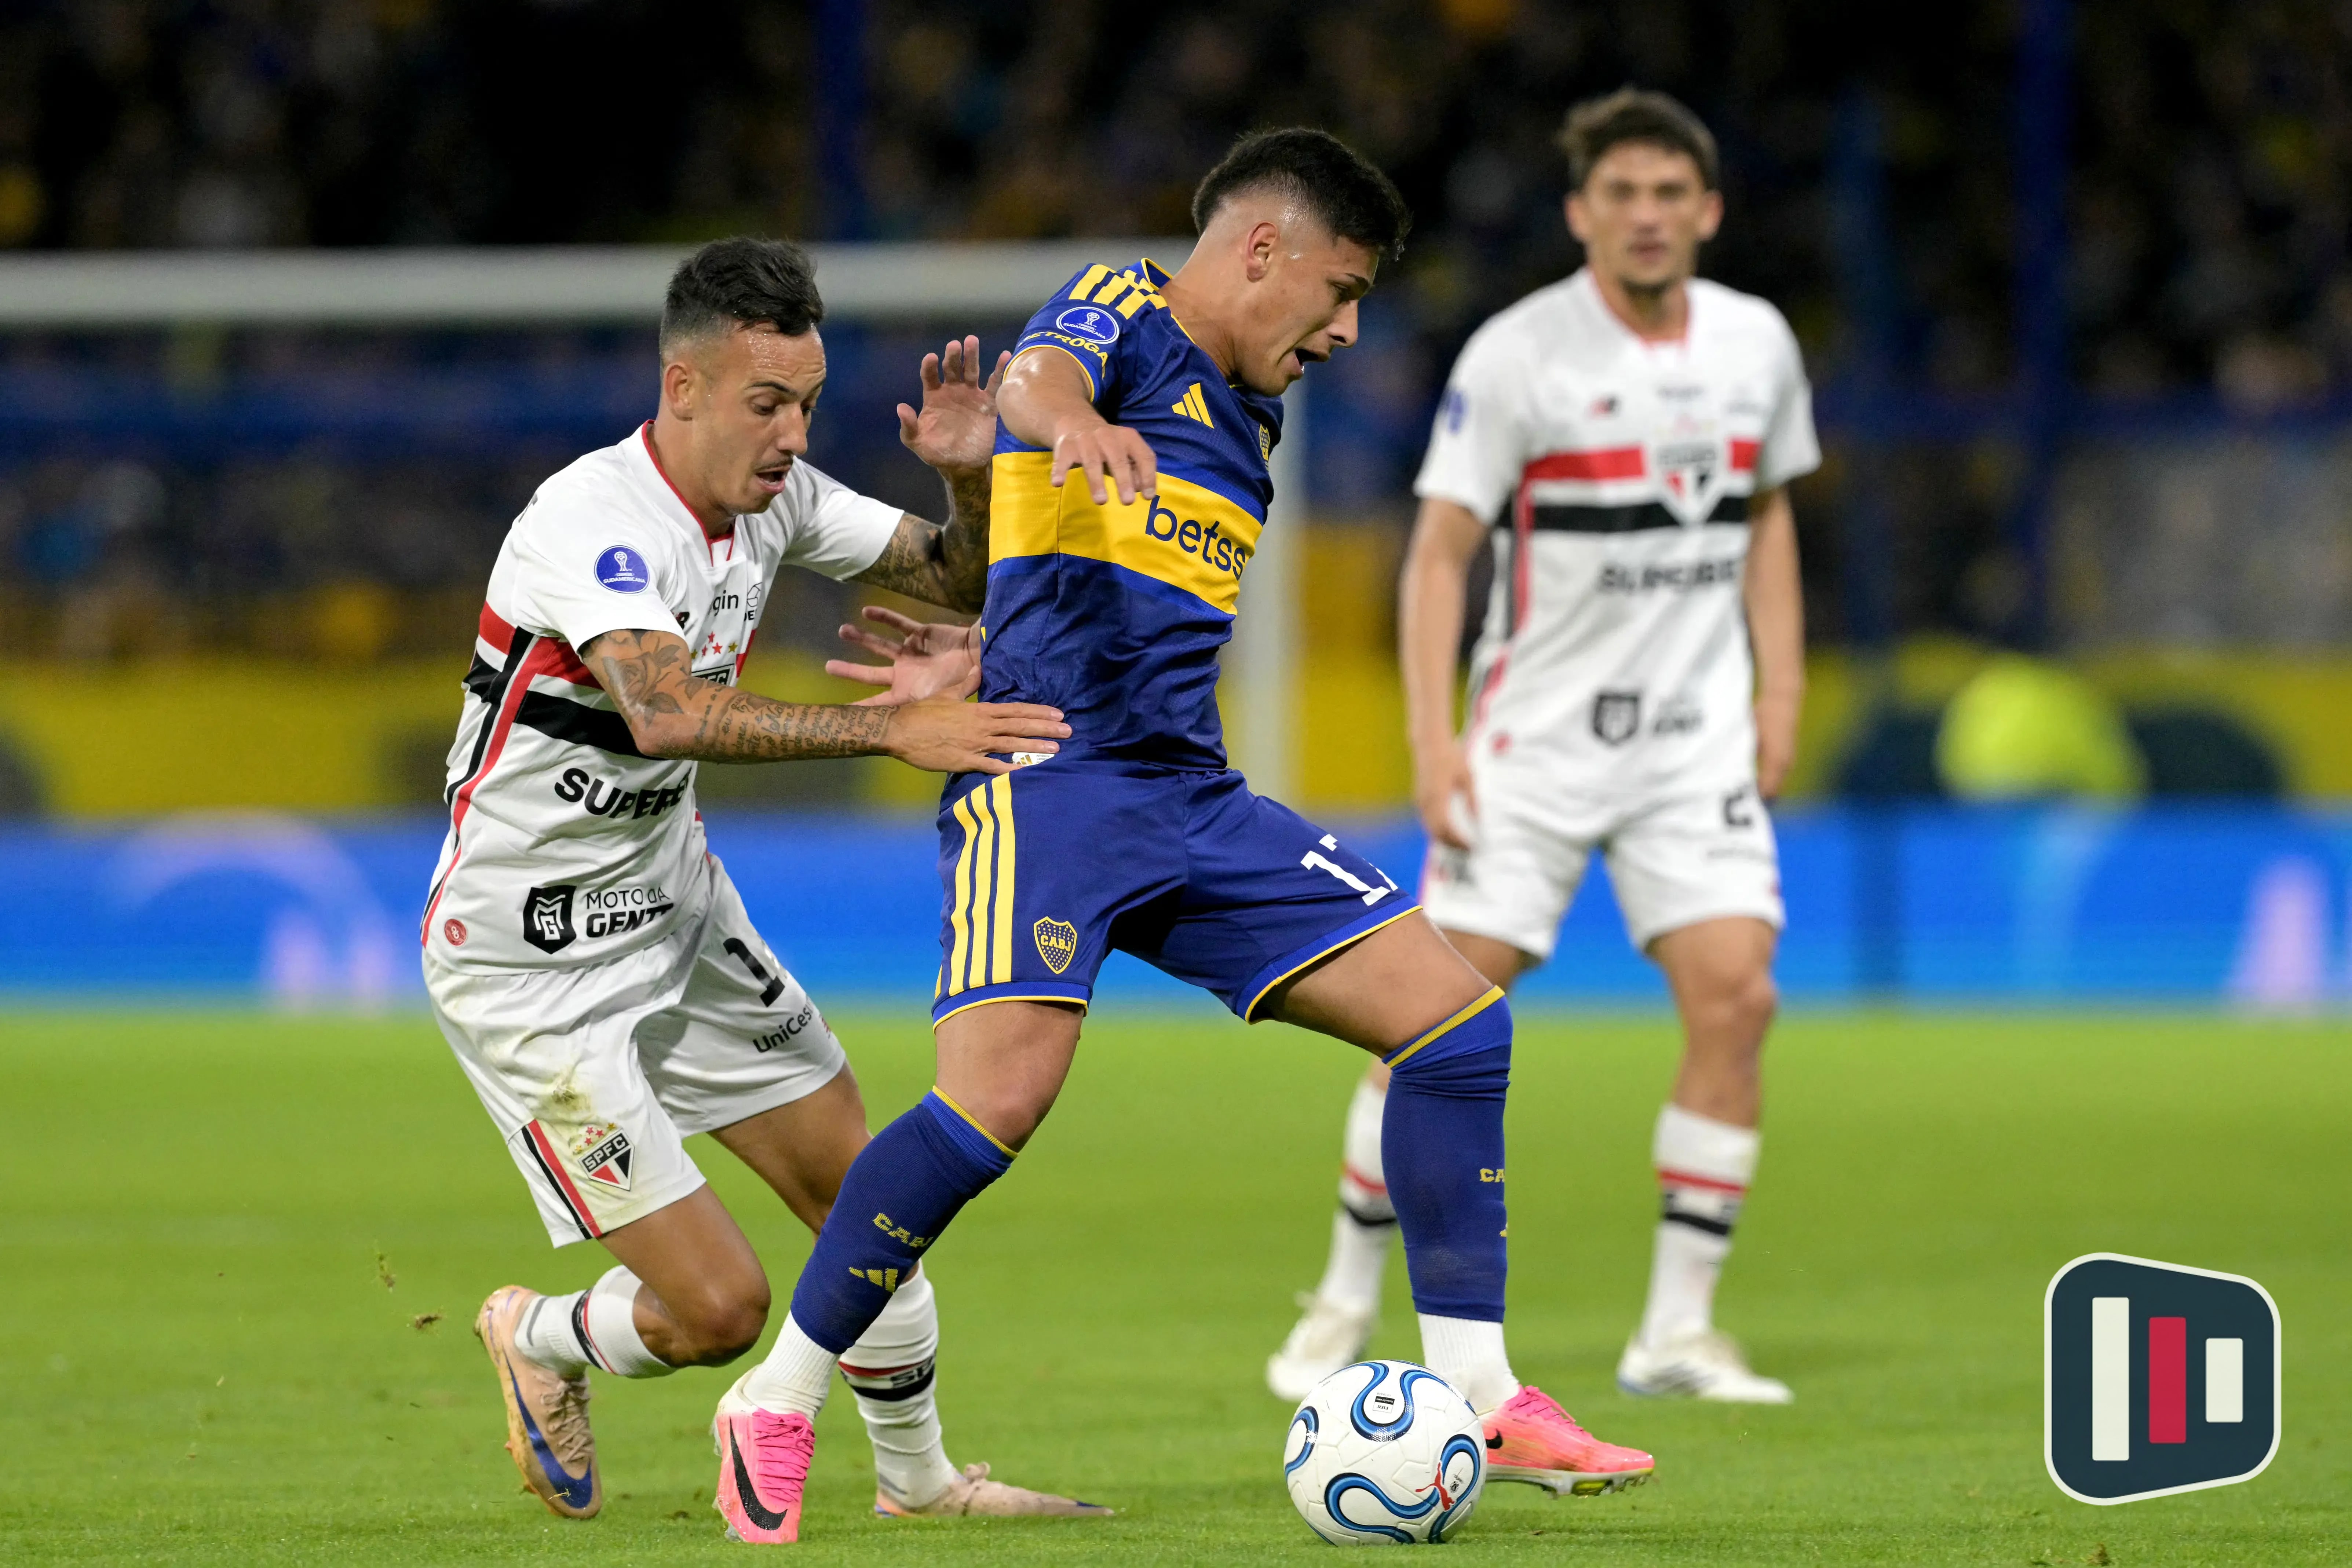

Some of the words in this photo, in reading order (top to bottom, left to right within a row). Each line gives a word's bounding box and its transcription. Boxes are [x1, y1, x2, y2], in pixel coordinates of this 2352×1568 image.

[1063, 322, 1106, 340] SUDAMERICANA
[708, 589, 739, 616] gin
[587, 888, 643, 909] MOTO
[1040, 935, 1072, 952] CABJ
[723, 937, 786, 1008] 1
[753, 1004, 814, 1053] UniCes
[584, 1136, 626, 1170] SPFC
